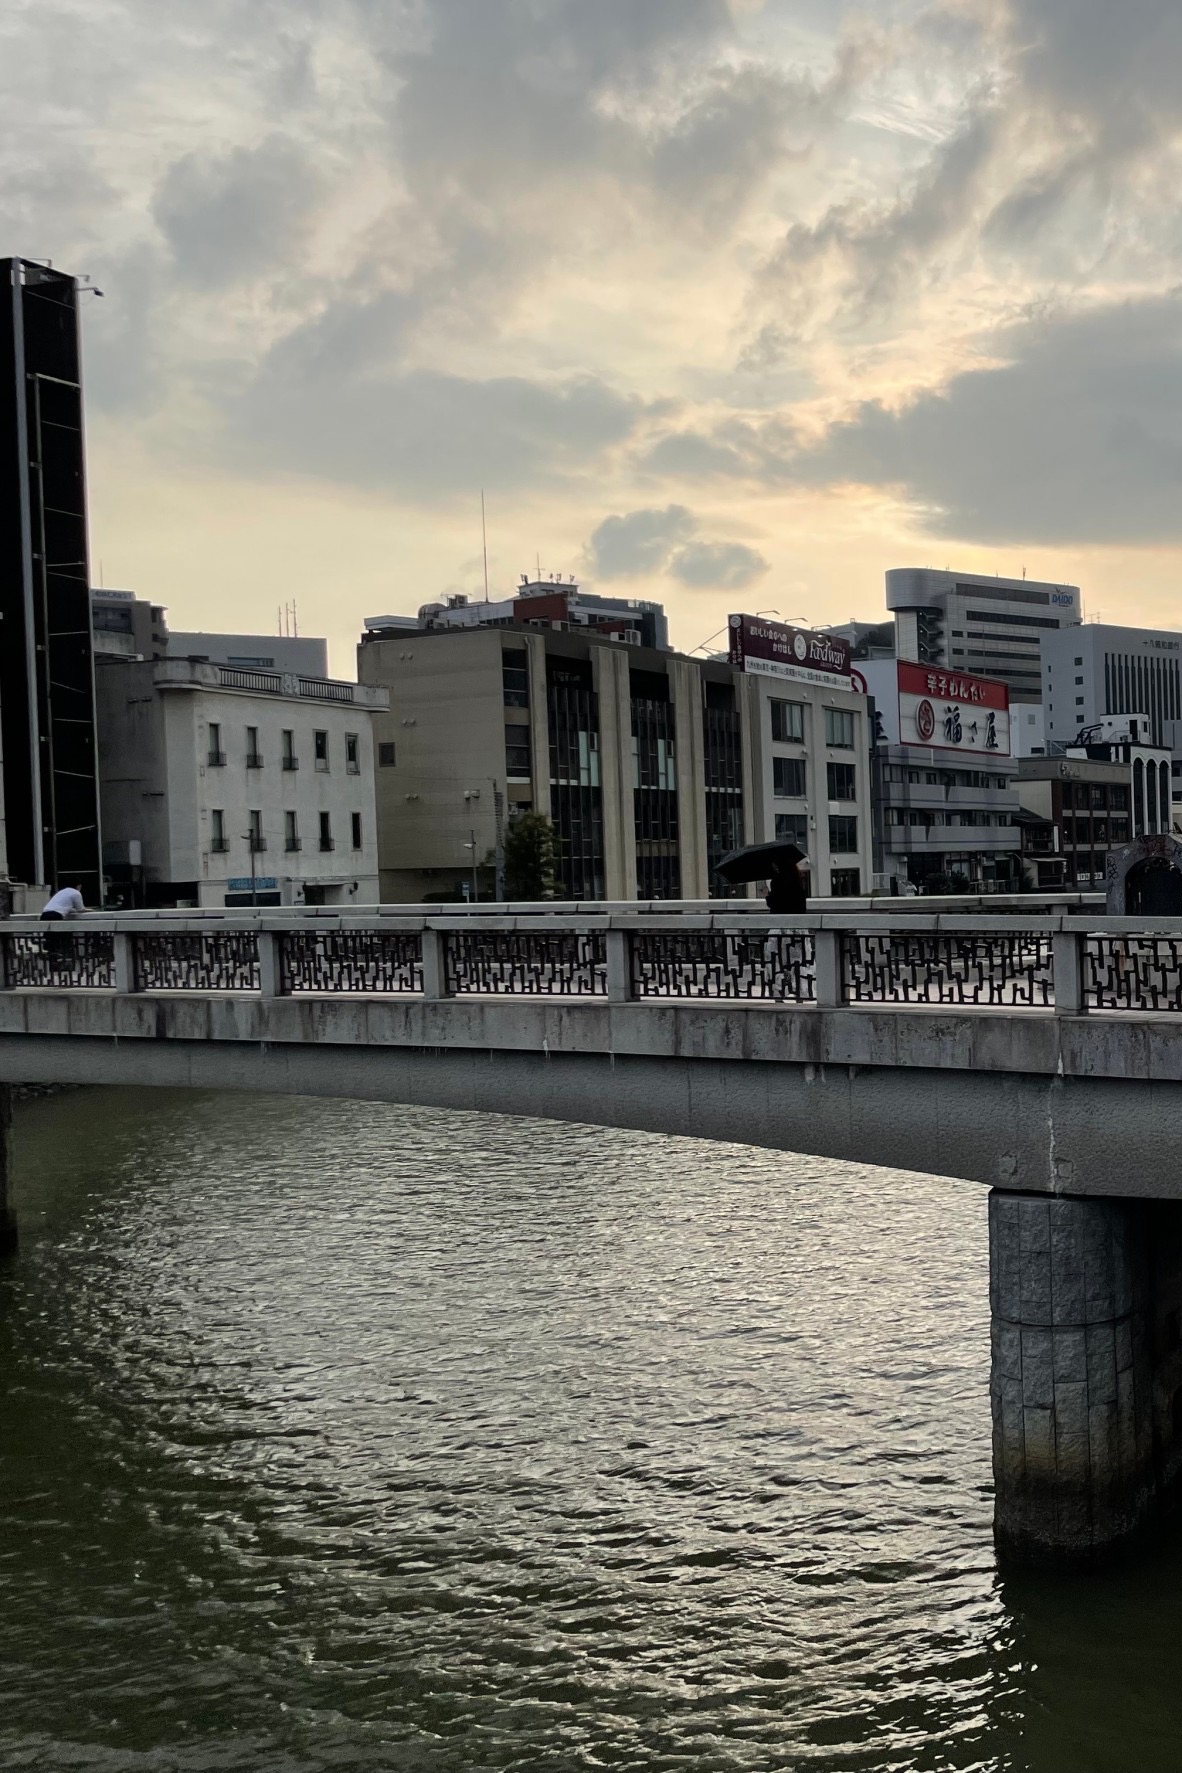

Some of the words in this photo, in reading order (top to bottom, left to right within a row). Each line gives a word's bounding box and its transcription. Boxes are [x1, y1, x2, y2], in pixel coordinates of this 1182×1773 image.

[927, 672, 986, 701] 辛子めんたい
[943, 705, 999, 749] 福さ屋
